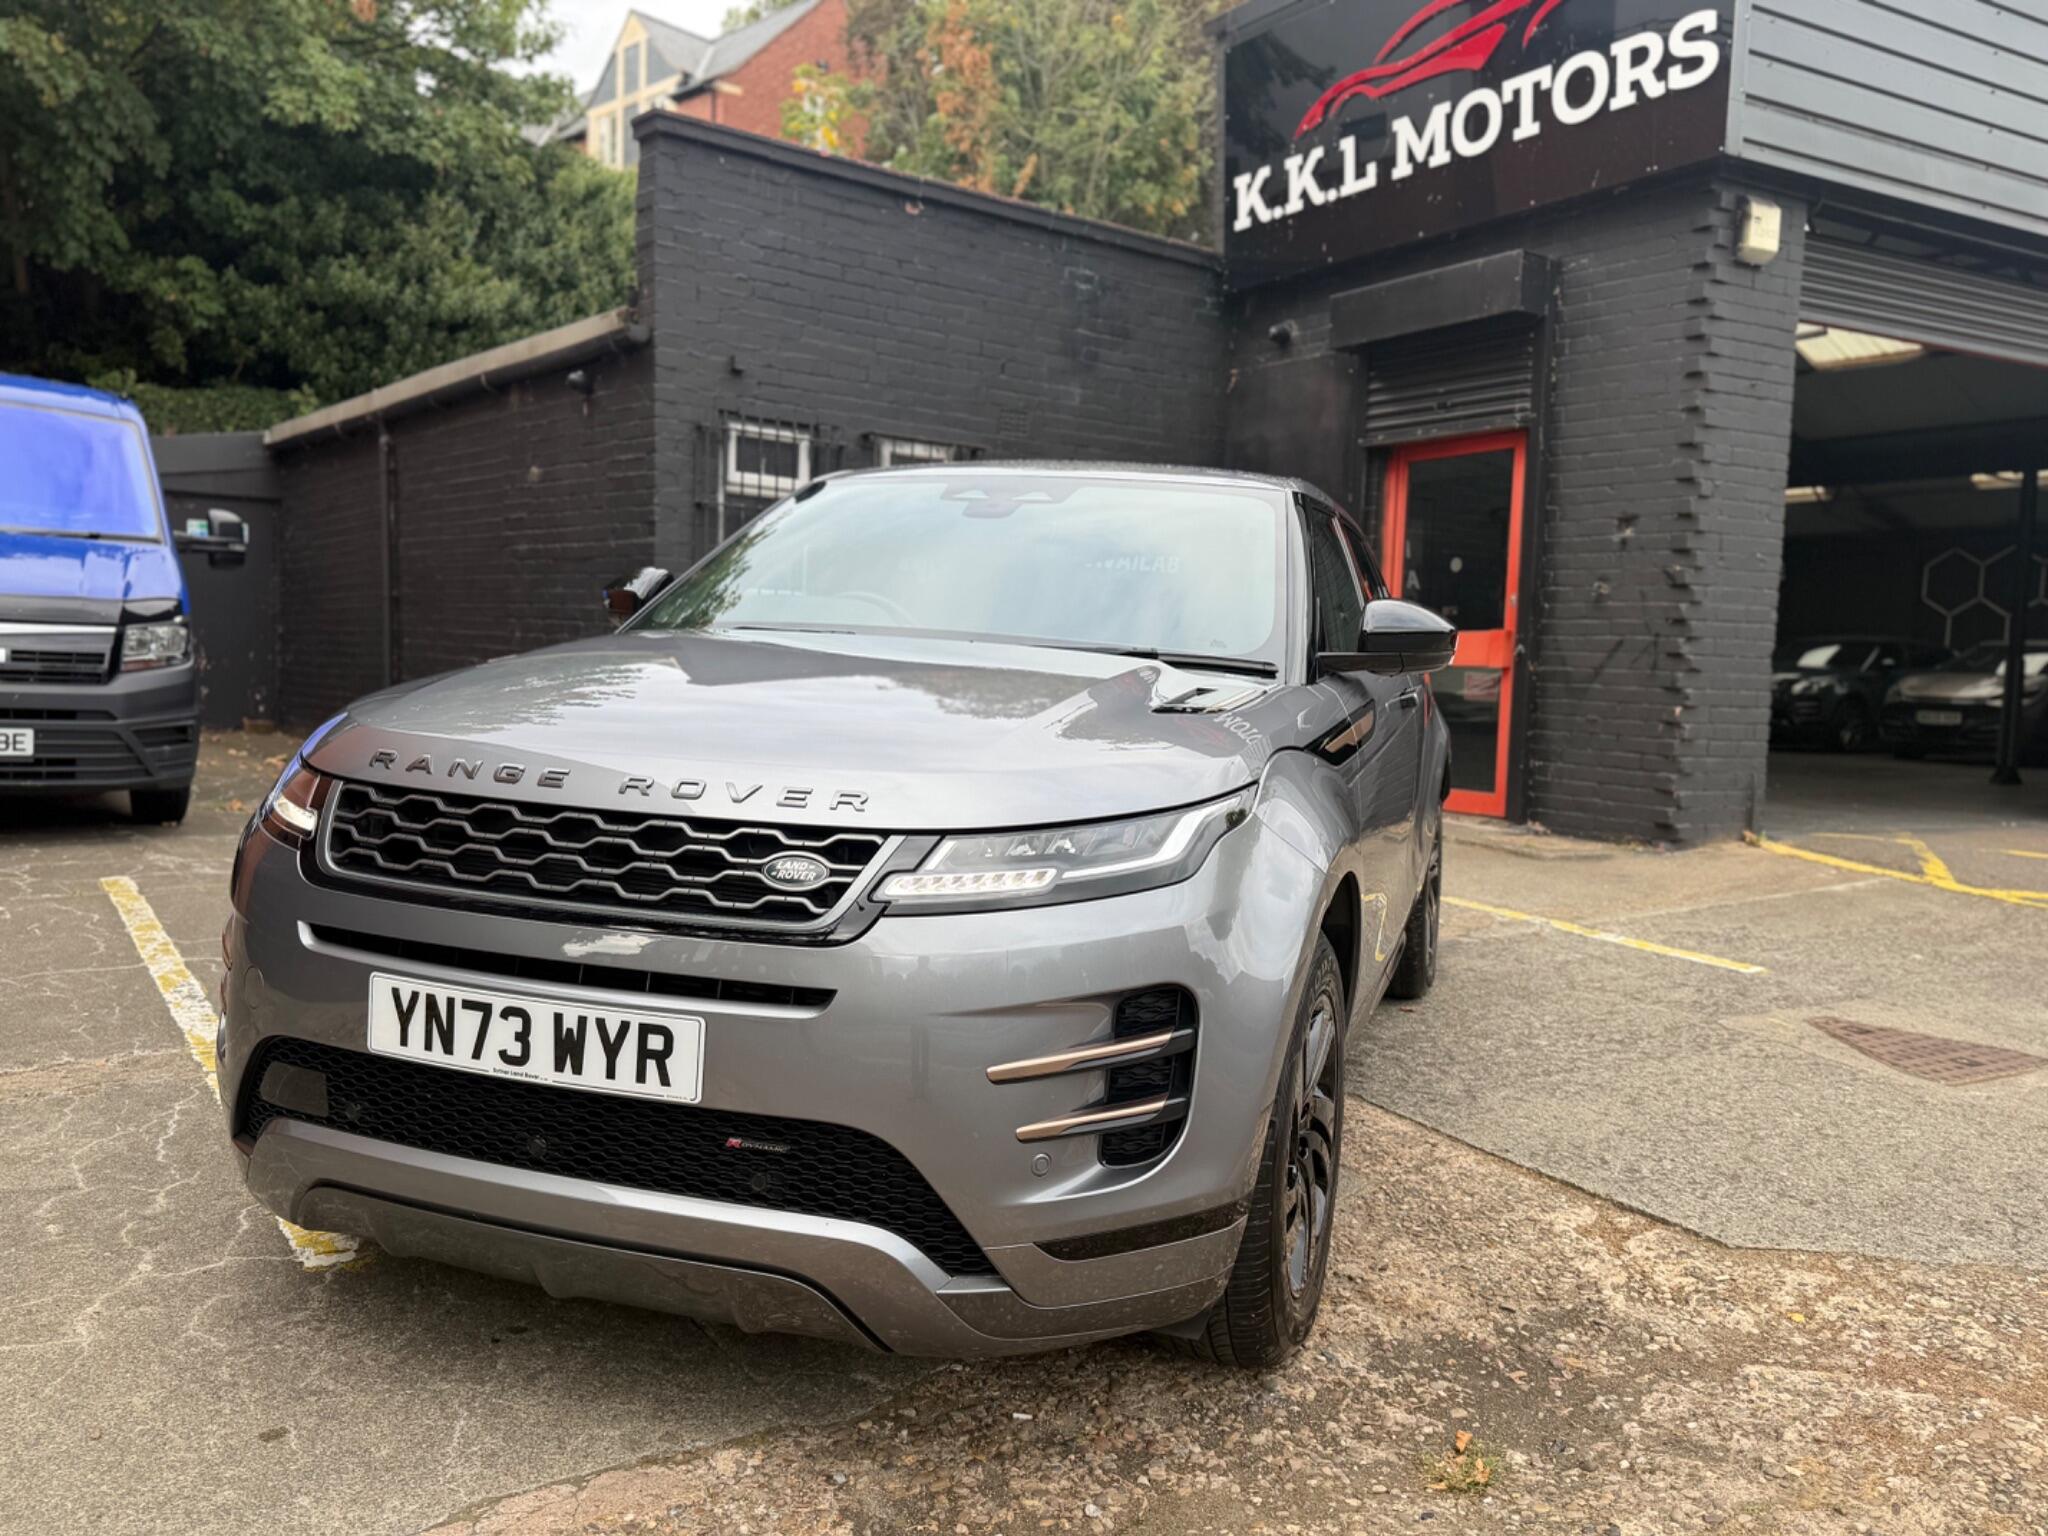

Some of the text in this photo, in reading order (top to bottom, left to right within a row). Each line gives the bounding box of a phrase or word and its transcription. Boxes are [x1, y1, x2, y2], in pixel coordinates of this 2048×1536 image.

[1233, 9, 1720, 232] K.K.L MOTORS
[369, 747, 869, 811] RANGE ROVER
[391, 987, 675, 1087] YN73 WYR
